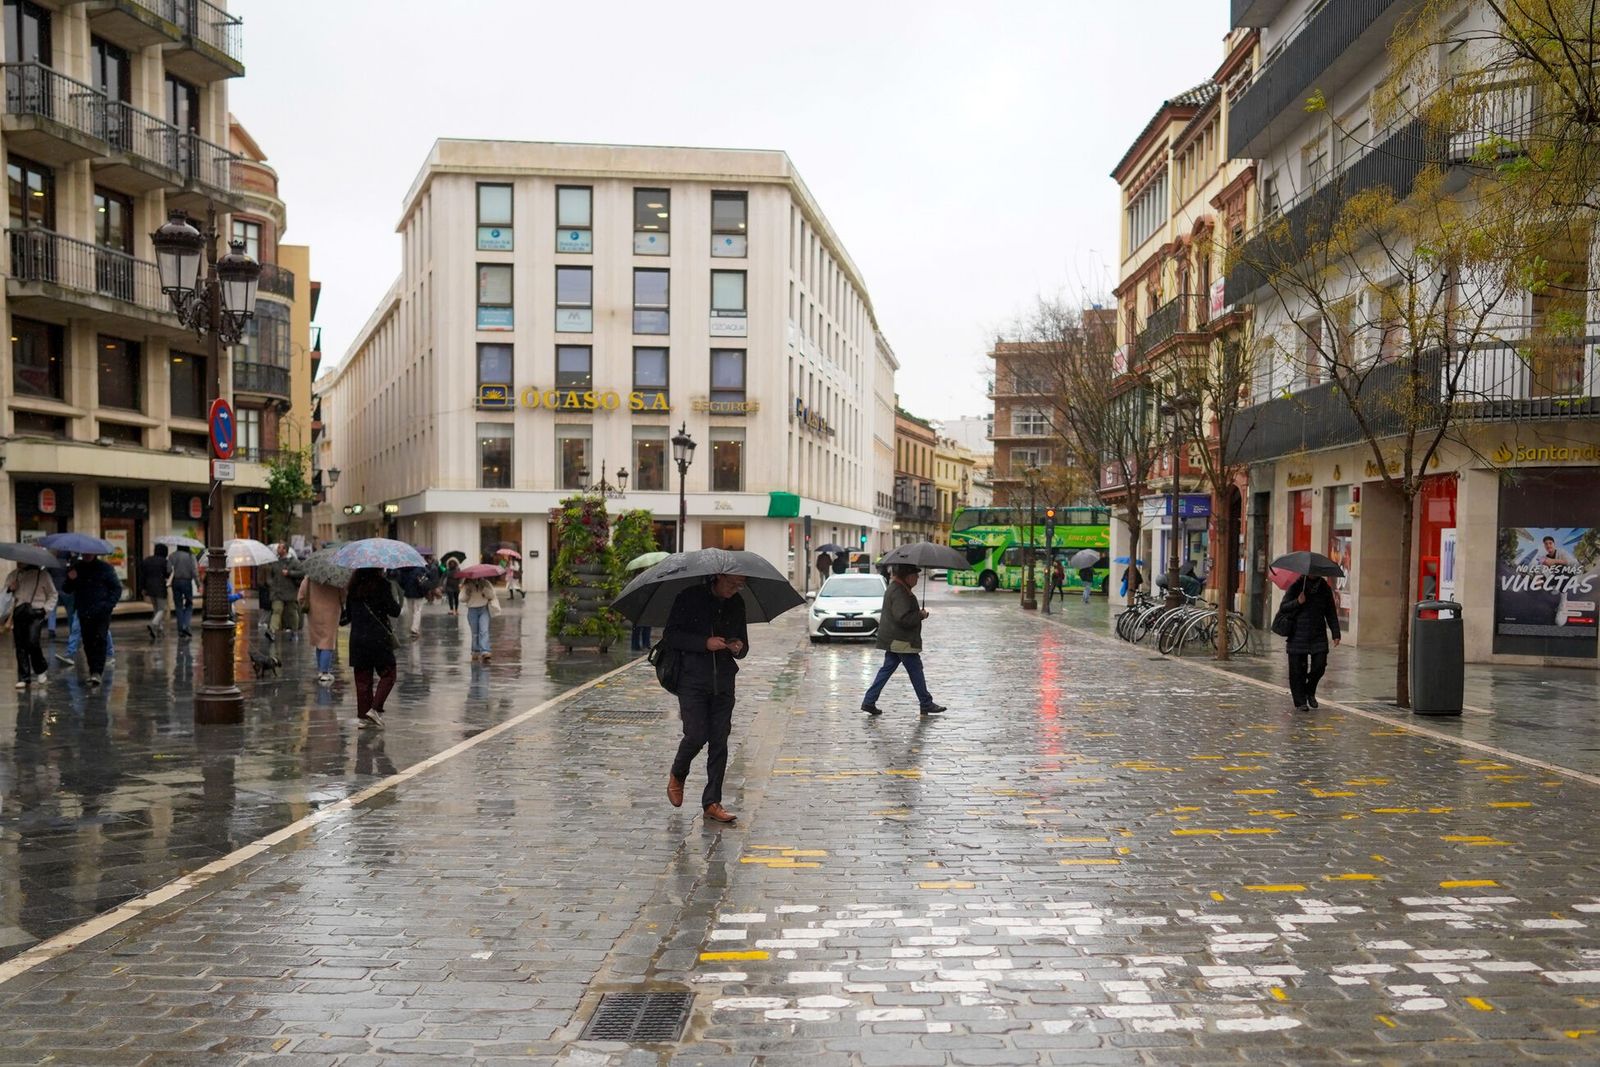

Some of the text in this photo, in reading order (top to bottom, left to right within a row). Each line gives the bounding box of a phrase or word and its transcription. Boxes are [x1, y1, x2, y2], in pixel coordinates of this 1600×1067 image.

[520, 389, 620, 411] OCASO
[1515, 565, 1528, 573] NO
[1529, 565, 1541, 573] LE
[1542, 565, 1560, 574] DES
[1501, 574, 1598, 594] VUELTAS
